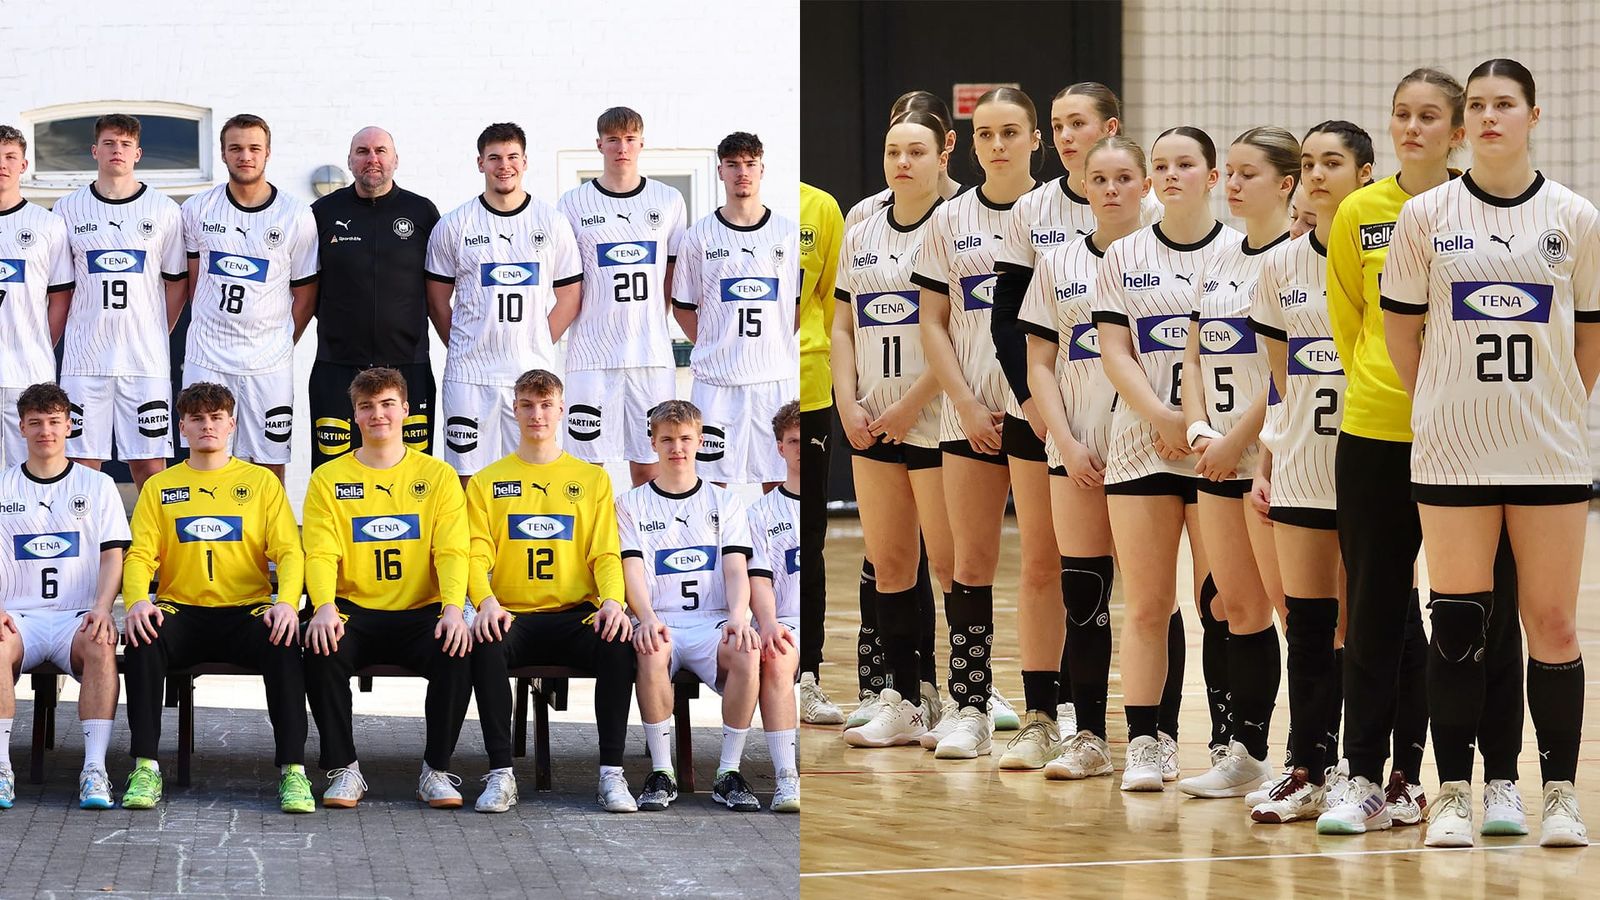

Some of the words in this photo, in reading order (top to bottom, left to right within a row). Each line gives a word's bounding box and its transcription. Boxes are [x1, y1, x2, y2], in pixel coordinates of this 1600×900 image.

[581, 214, 606, 227] hella
[74, 222, 98, 235] hella
[202, 222, 226, 234] hella
[465, 235, 490, 247] hella
[1031, 229, 1065, 244] hella
[1361, 226, 1392, 245] hell
[1433, 235, 1474, 253] hella
[614, 248, 640, 258] TENA
[706, 248, 730, 260] hella
[103, 256, 128, 266] TENA
[224, 259, 249, 272] TENA
[853, 253, 878, 268] hella
[498, 270, 522, 279] TENA
[1123, 272, 1161, 288] hella
[613, 272, 648, 302] 20
[737, 284, 763, 294] TENA
[1055, 282, 1087, 301] hella
[102, 279, 128, 309] 19
[219, 283, 245, 314] 18
[1279, 289, 1307, 308] hella
[498, 293, 523, 322] 10
[1479, 295, 1523, 308] TENA
[873, 303, 905, 314] TENA
[738, 308, 762, 337] 15
[1161, 327, 1188, 338] TEN
[1203, 330, 1231, 342] TENA
[882, 335, 901, 378] 11
[1476, 334, 1533, 382] 20
[1214, 367, 1234, 412] 5
[1314, 388, 1338, 436] 2
[568, 418, 601, 427] HARTING
[316, 430, 351, 440] HARTING
[447, 430, 478, 439] HARTING
[161, 489, 189, 500] hella
[335, 484, 364, 496] hella
[494, 483, 521, 495] hella
[0, 502, 26, 513] hella
[194, 525, 222, 534] TENA
[371, 524, 400, 533] TENA
[526, 522, 554, 532] TENA
[639, 520, 666, 533] hella
[33, 541, 61, 551] TENA
[206, 550, 214, 581] 1
[374, 548, 402, 581] 16
[527, 548, 554, 580] 12
[673, 554, 702, 565] TENA
[41, 567, 58, 599] 6
[681, 580, 699, 610] 5
